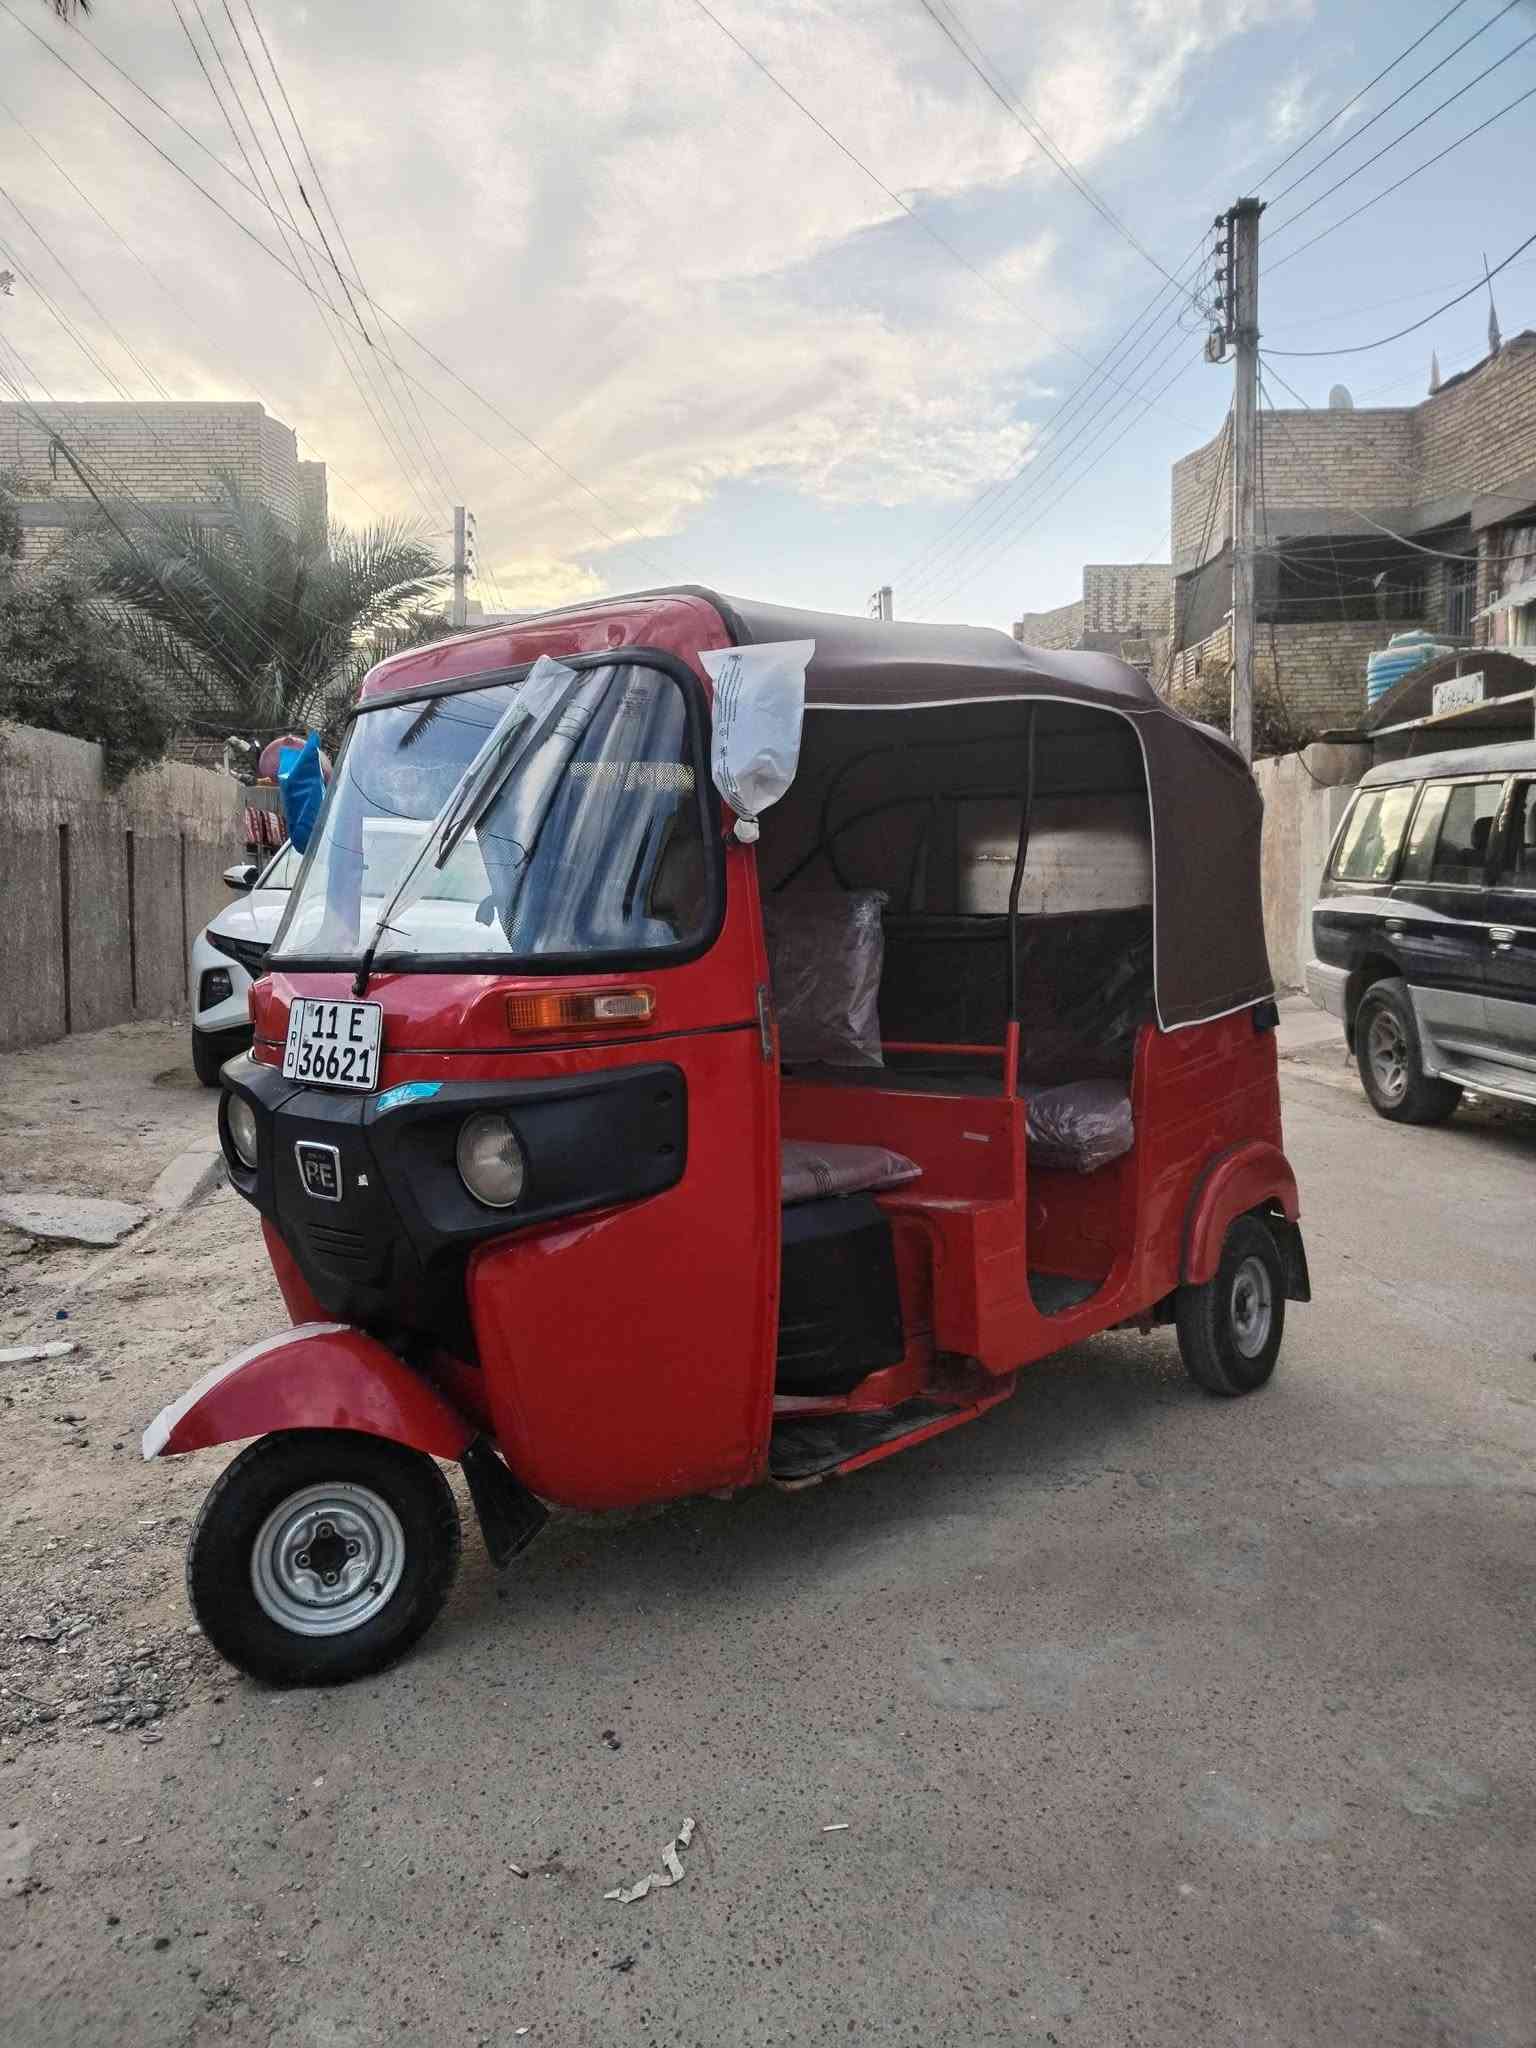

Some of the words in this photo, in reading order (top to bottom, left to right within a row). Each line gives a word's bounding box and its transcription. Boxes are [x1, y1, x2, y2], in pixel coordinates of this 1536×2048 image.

[312, 1005, 338, 1039] 11
[349, 1008, 365, 1042] E
[298, 1043, 371, 1084] 36621
